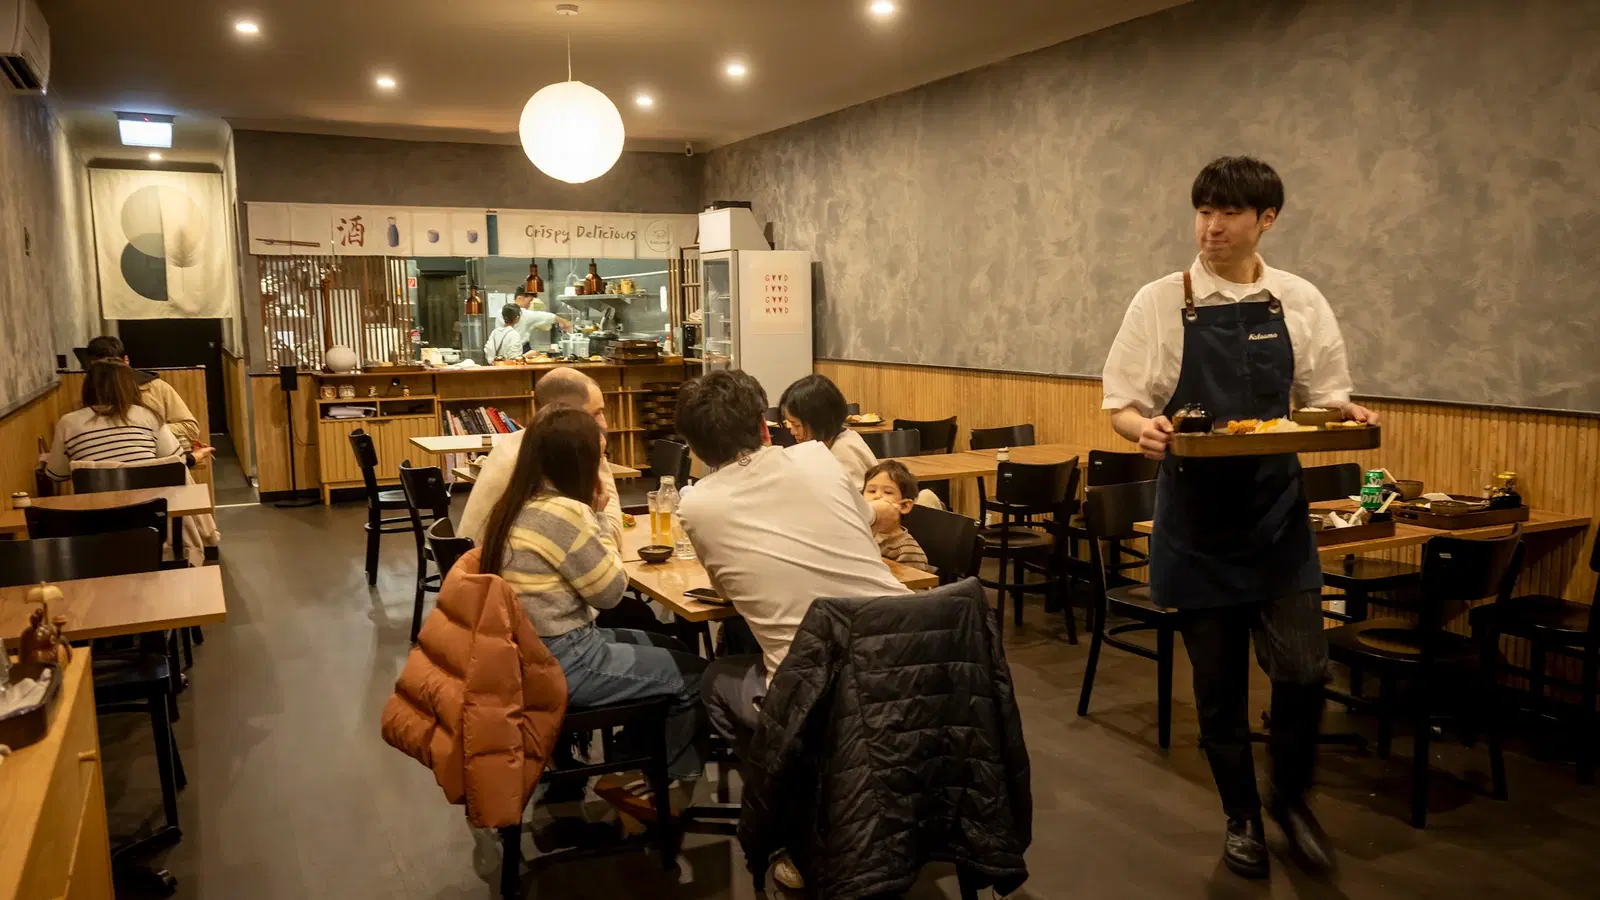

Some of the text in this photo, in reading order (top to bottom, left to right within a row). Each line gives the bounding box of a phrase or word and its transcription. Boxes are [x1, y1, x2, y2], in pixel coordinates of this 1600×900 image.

[336, 215, 365, 248] 酒
[525, 225, 637, 244] Crispy Delicious
